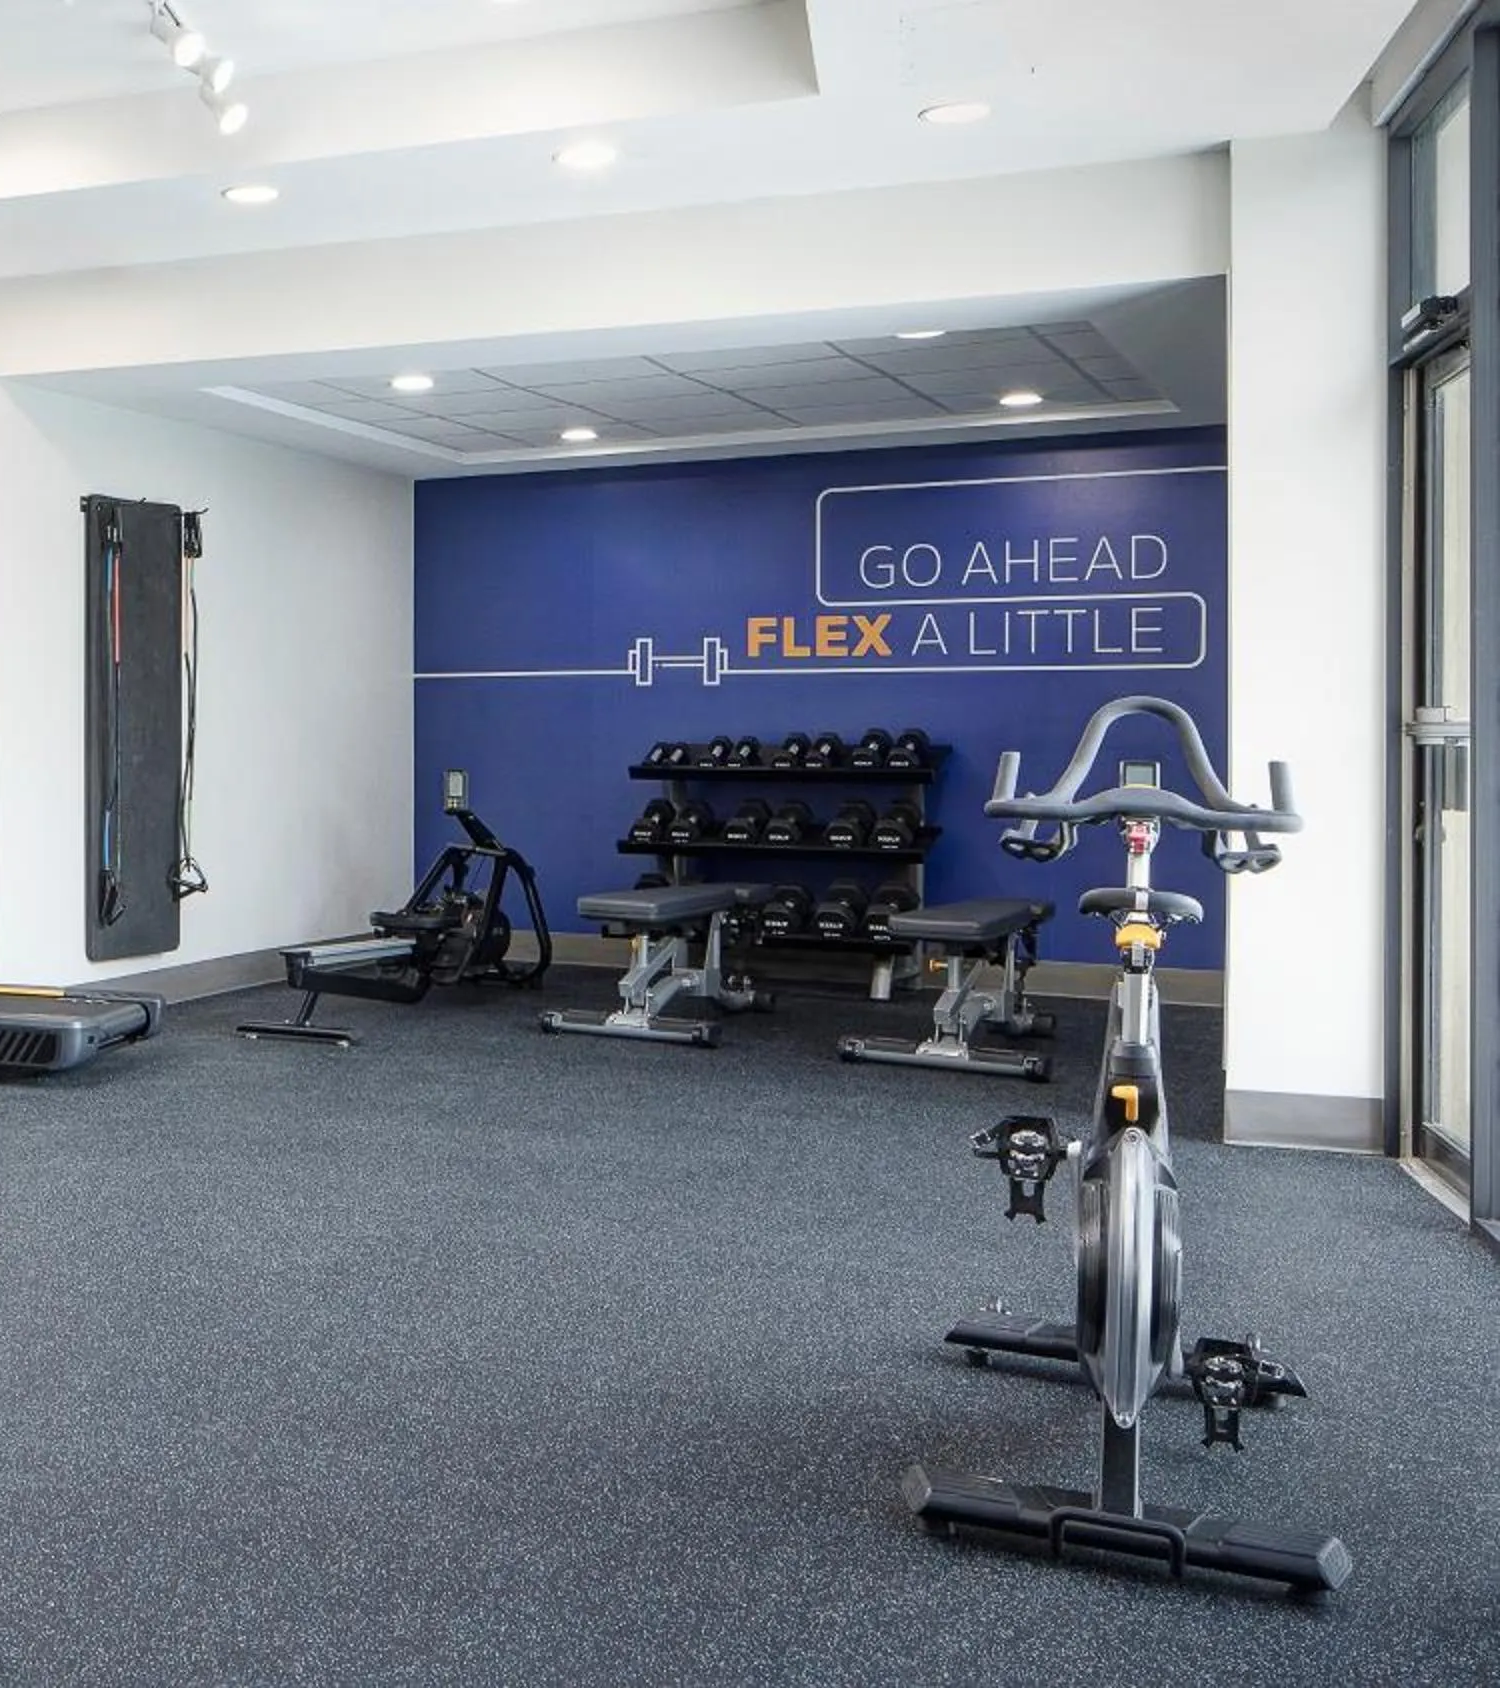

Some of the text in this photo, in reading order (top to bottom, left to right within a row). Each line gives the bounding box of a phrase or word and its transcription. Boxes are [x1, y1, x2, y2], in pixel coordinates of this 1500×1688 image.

[859, 535, 1168, 589] GO AHEAD
[747, 607, 1163, 658] FLEX A LITTLE
